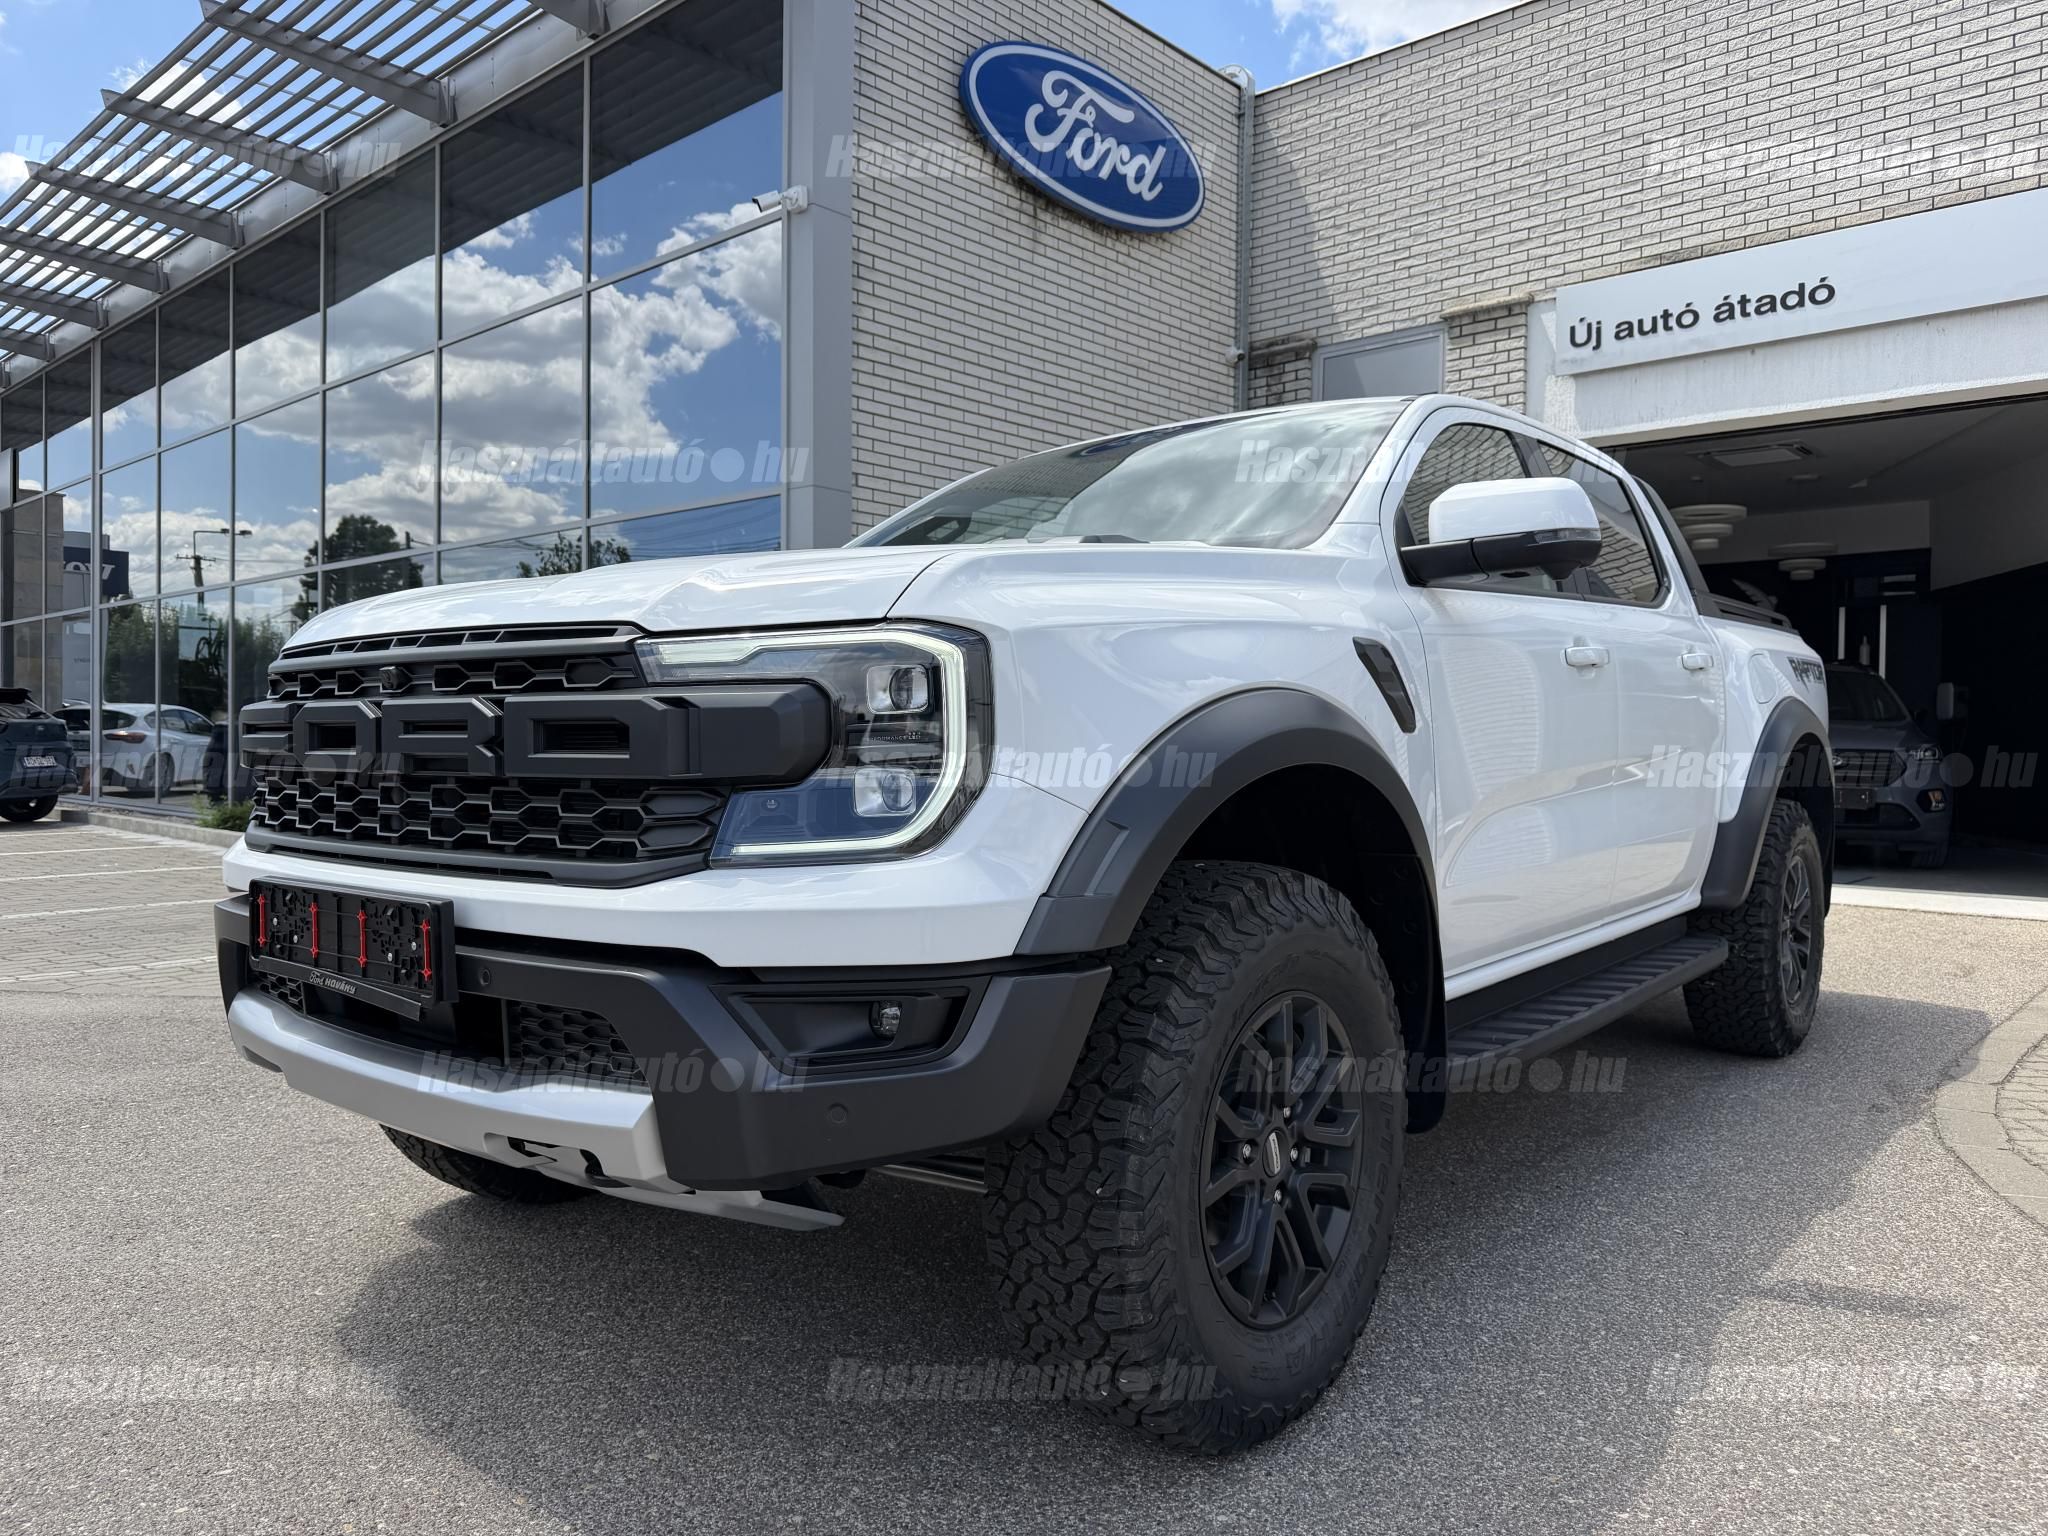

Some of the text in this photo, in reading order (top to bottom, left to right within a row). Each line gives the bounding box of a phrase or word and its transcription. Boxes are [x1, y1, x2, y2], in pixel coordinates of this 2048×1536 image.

[1024, 68, 1165, 202] Ford
[1568, 277, 1837, 352] Új autó átadó
[239, 695, 670, 778] FORD
[309, 970, 324, 986] Ford
